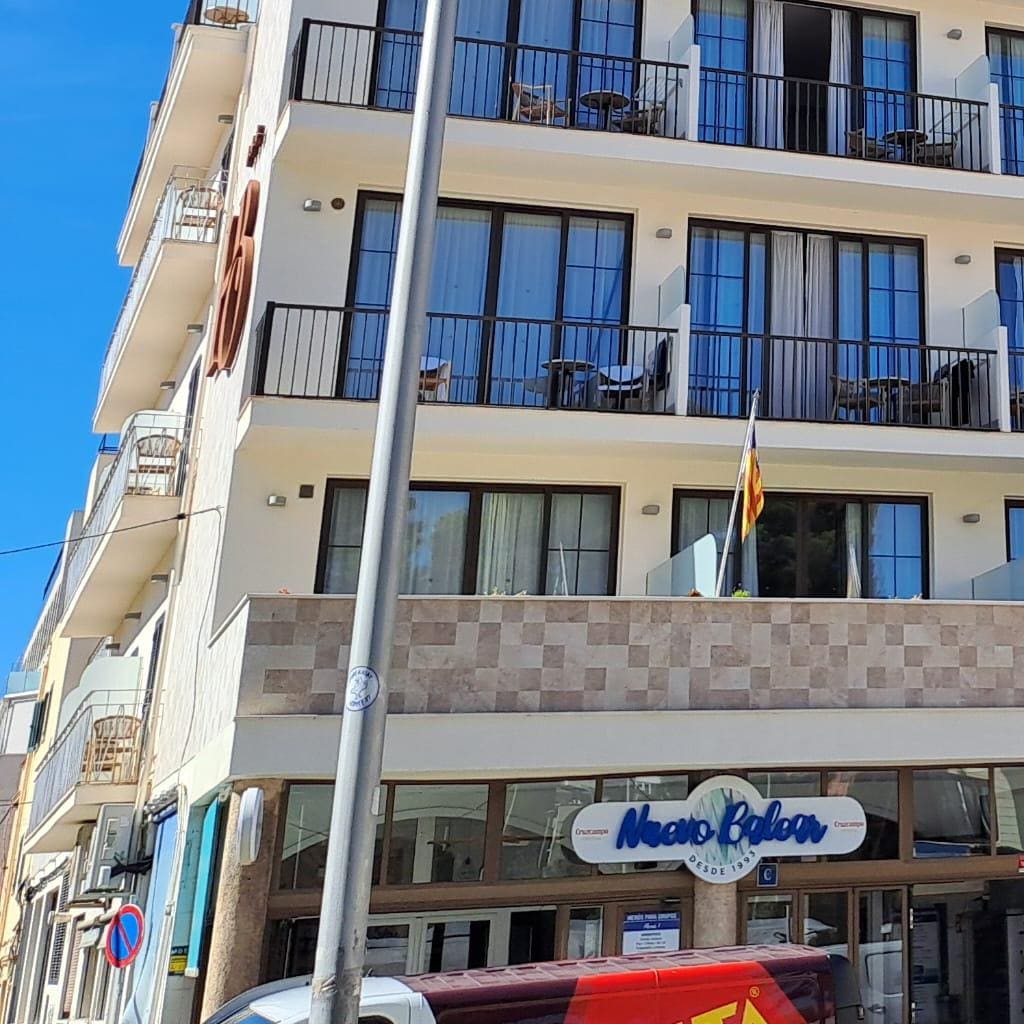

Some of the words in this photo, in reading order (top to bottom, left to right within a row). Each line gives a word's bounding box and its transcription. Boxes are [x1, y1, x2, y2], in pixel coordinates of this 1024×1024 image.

[616, 803, 715, 849] Nuevo
[717, 800, 828, 846] Balear
[688, 853, 726, 876] DESDE
